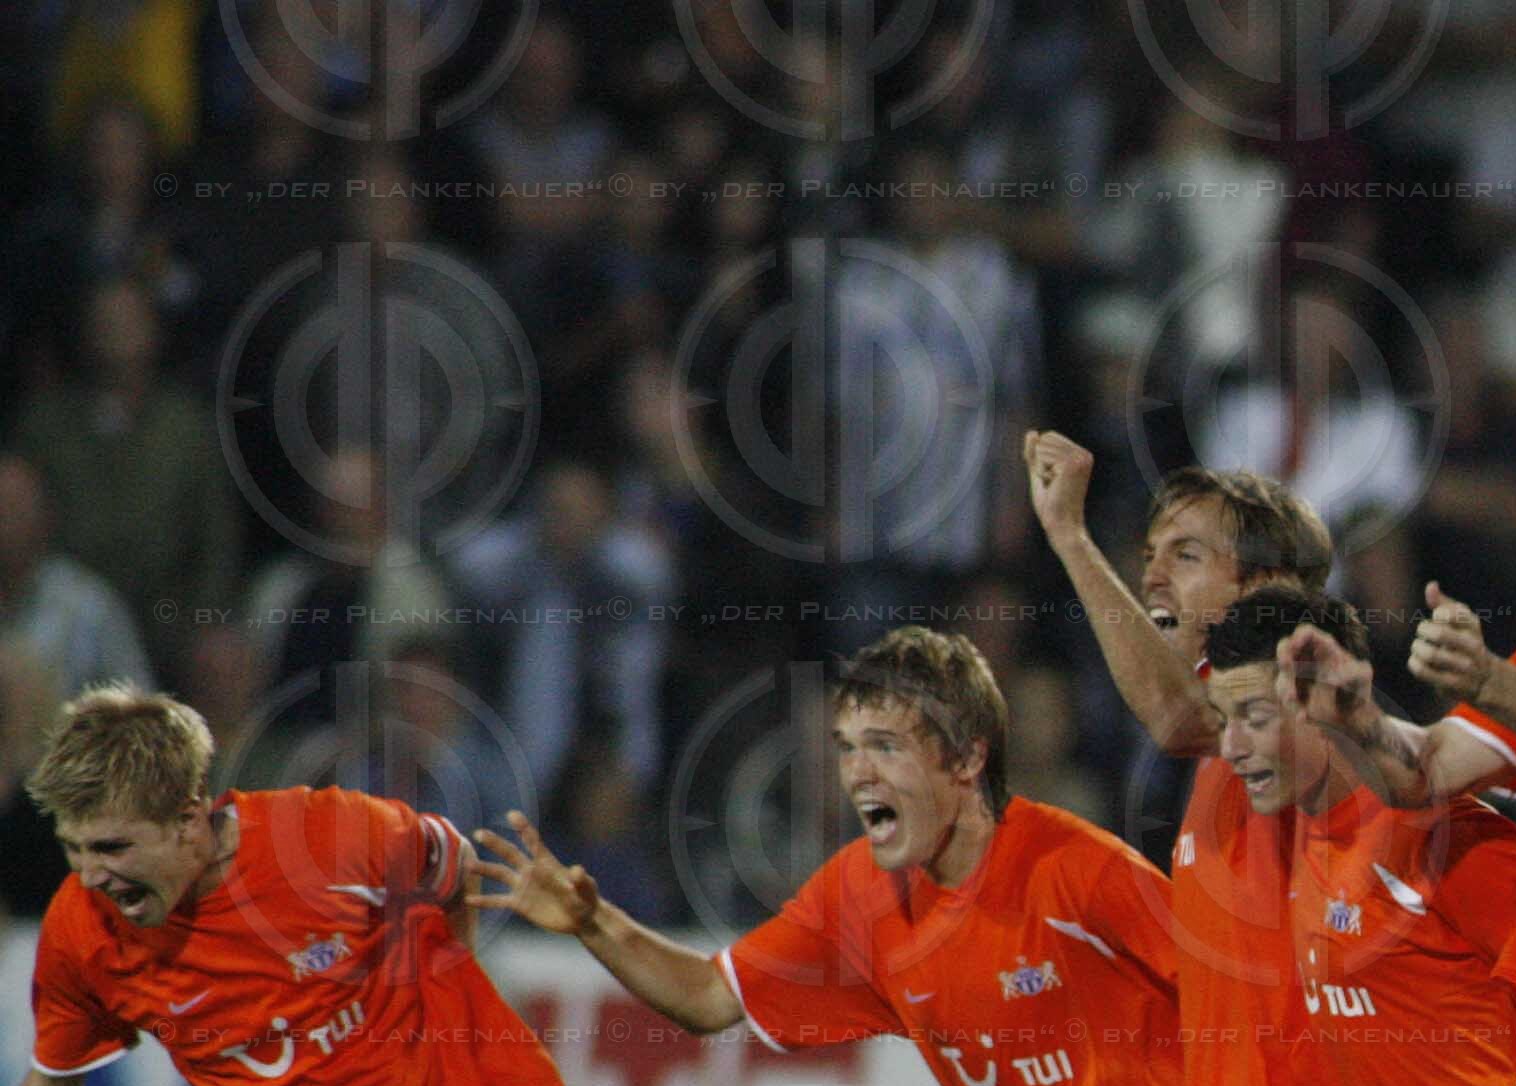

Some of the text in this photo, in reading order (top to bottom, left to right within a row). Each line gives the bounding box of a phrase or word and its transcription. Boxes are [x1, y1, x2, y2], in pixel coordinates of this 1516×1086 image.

[1321, 983, 1377, 1018] TUI
[307, 1000, 366, 1056] TUI
[1011, 1048, 1074, 1086] TUI
